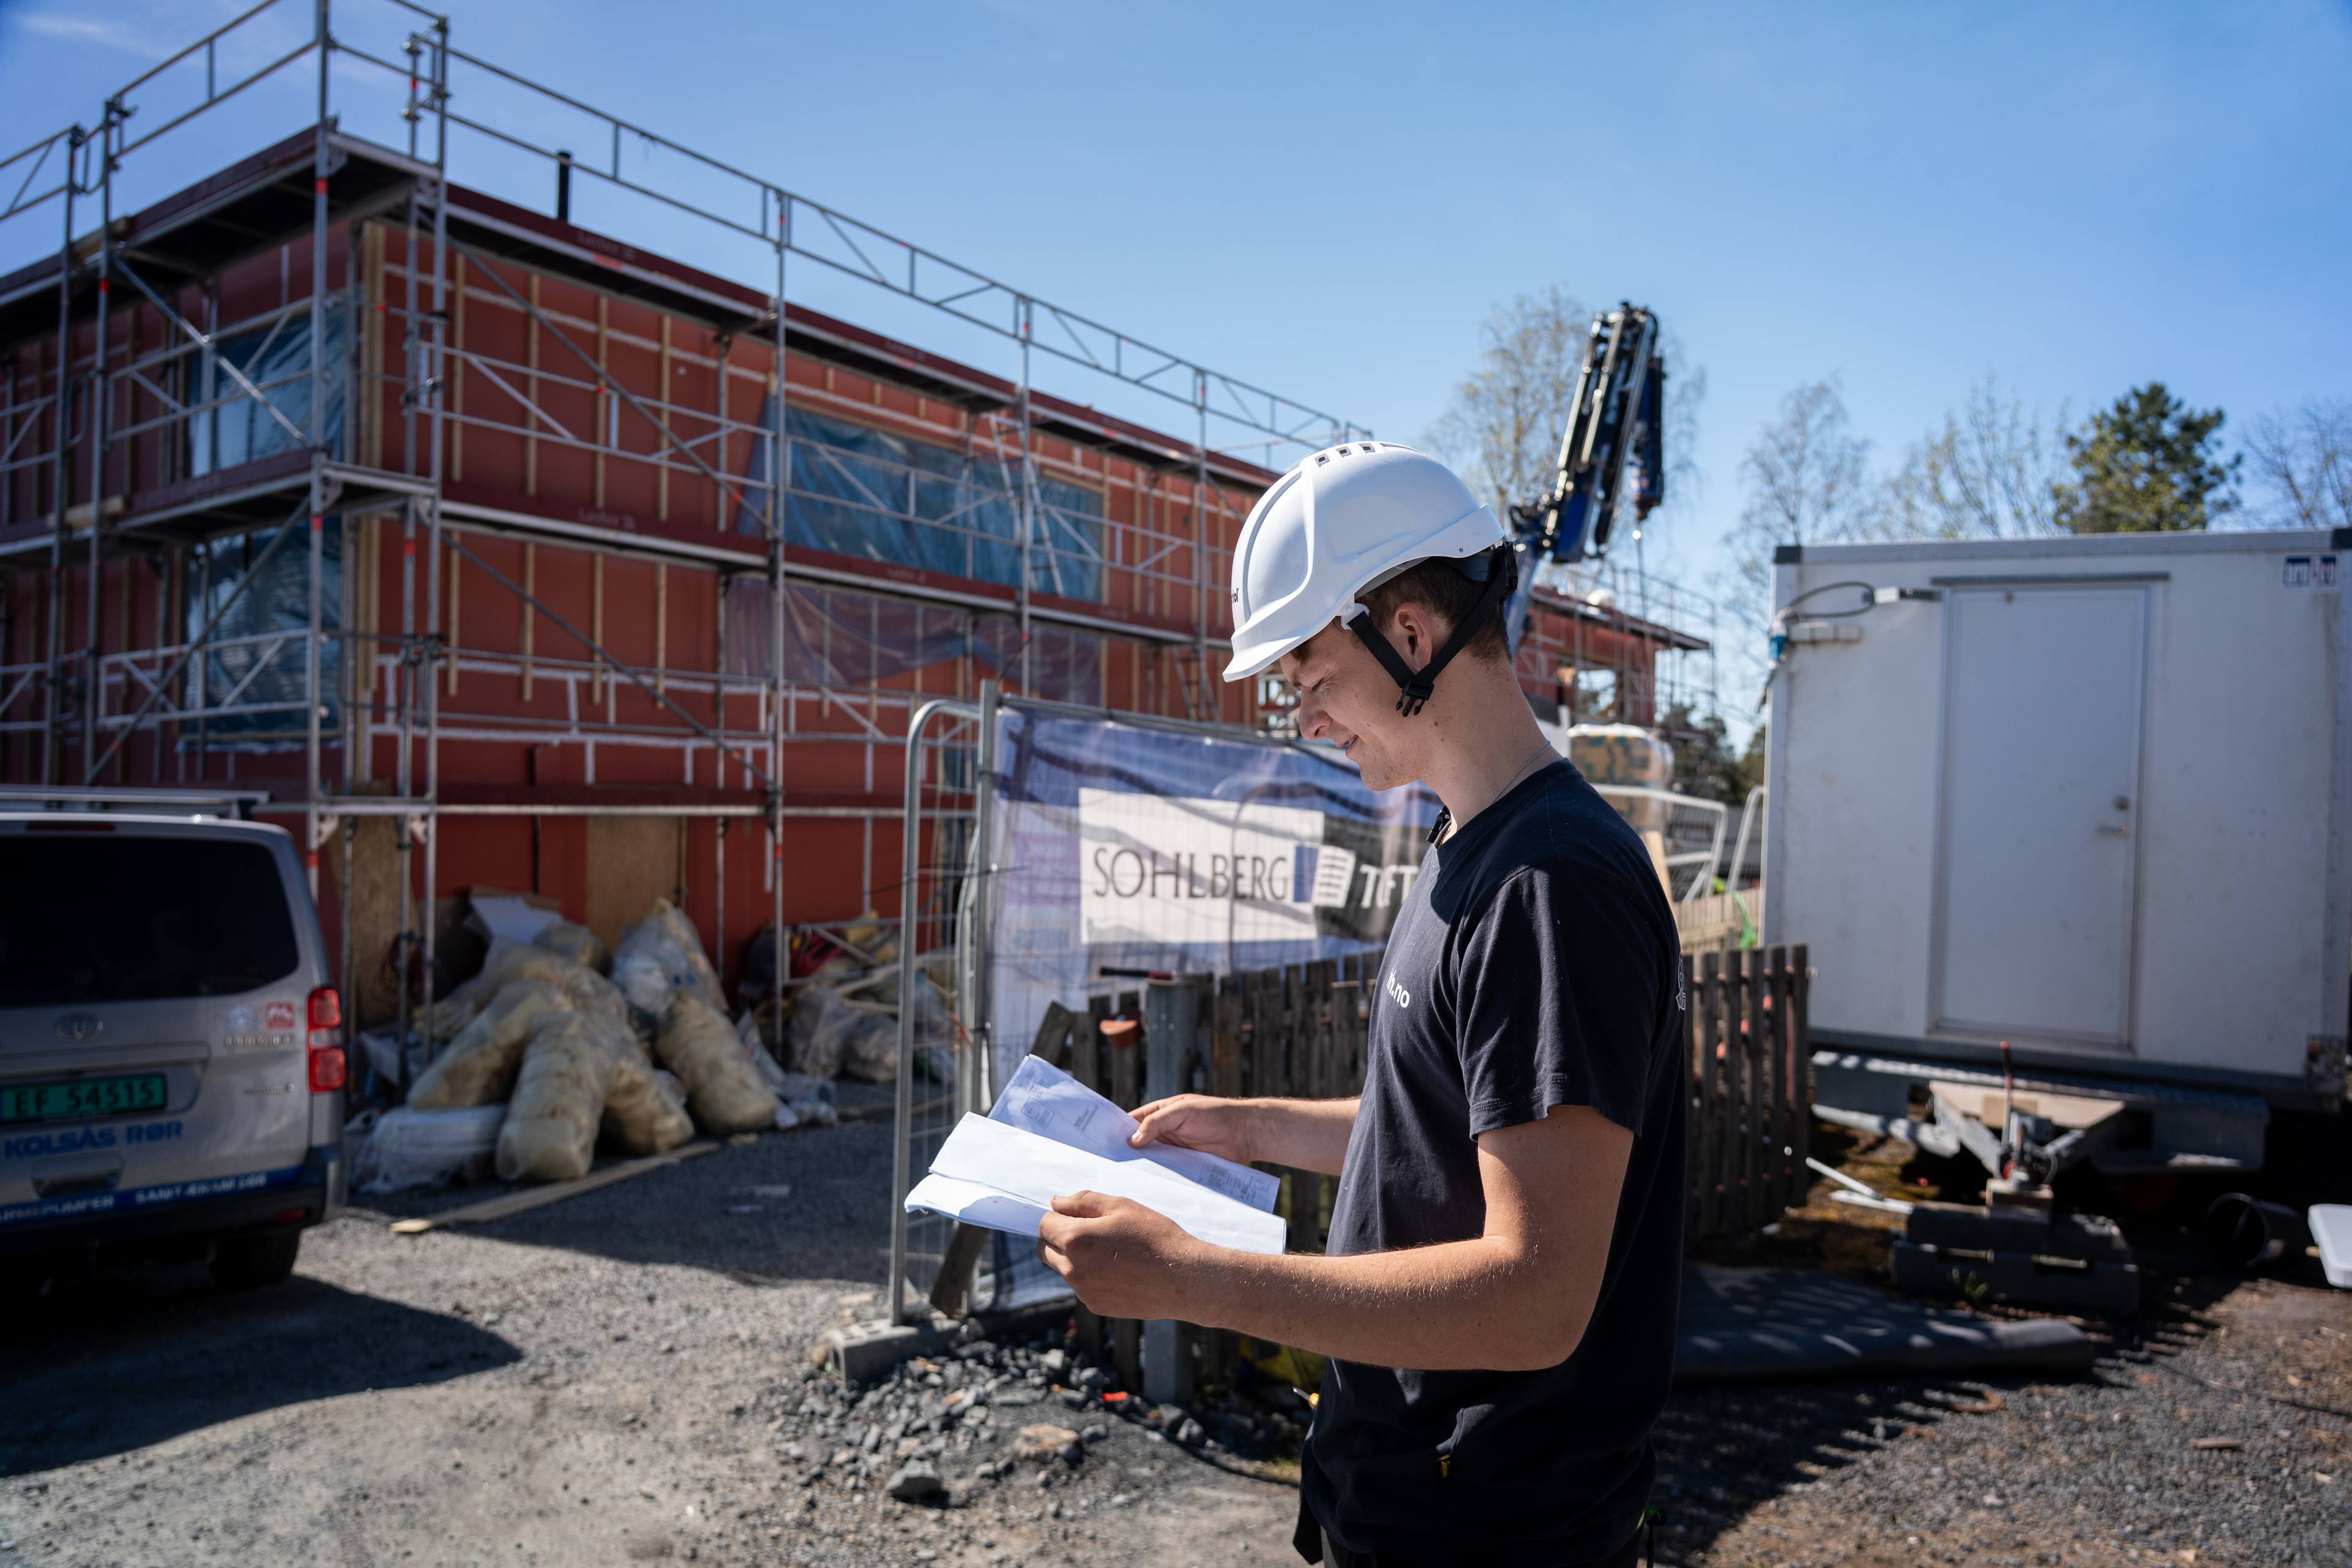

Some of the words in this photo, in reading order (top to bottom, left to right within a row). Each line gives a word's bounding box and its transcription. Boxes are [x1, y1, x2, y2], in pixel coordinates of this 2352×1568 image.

[1094, 848, 1287, 900] SOHLBERG
[16, 1088, 49, 1115] EF
[67, 1079, 154, 1110] 54515
[4, 1125, 116, 1159] KOLSÅS
[126, 1120, 183, 1144] RØR
